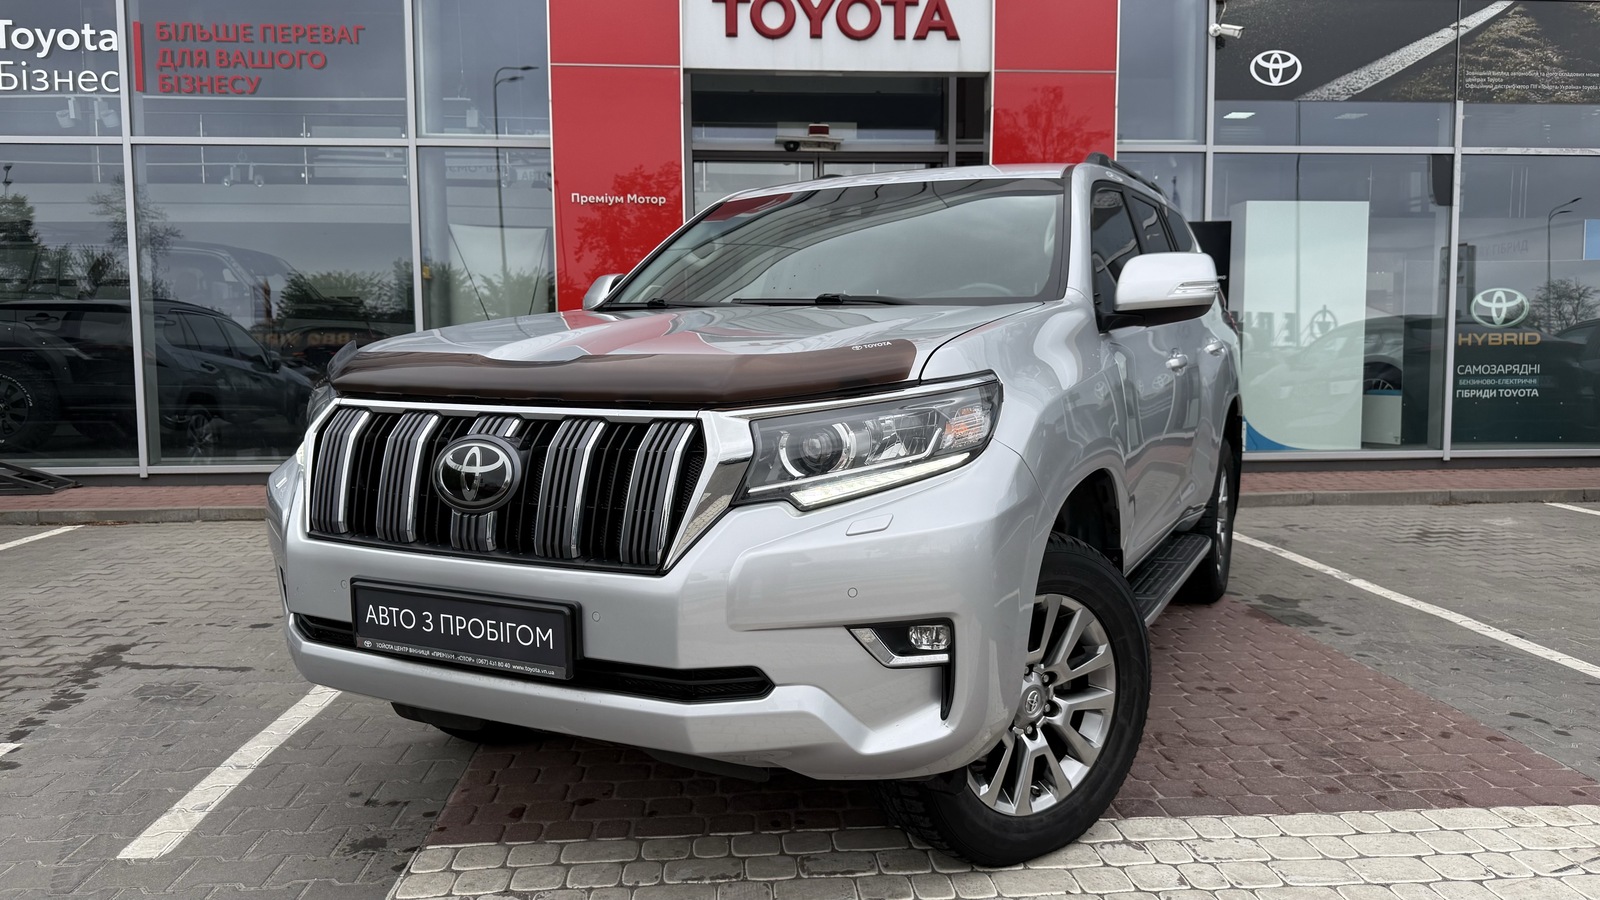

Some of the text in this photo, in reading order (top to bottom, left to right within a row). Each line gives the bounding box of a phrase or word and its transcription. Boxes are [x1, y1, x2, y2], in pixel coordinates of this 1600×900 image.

[712, 0, 960, 40] TOYOTA
[0, 19, 119, 58] Toyota
[156, 22, 365, 44] БІЛЬШЕ ПЕРЕВАГ
[156, 48, 327, 70] ДЛЯ ВАШОГО
[0, 61, 120, 93] Бізнес
[159, 75, 261, 94] БІЗНЕСУ
[571, 193, 666, 206] Преміум Мотор
[863, 341, 892, 349] TOYOTA
[1458, 332, 1541, 346] HYBRID
[1457, 364, 1540, 375] САМОЗАРЯДНІ
[1459, 378, 1537, 386] БЕНЗИНОВО-ЕЛЕКТРИЧНІ
[1456, 389, 1539, 399] ГІБРИДИ TOYOTA
[366, 604, 553, 650] АВТО З ПРОБІГОМ
[512, 664, 554, 675] www.toyota.vn.ua
